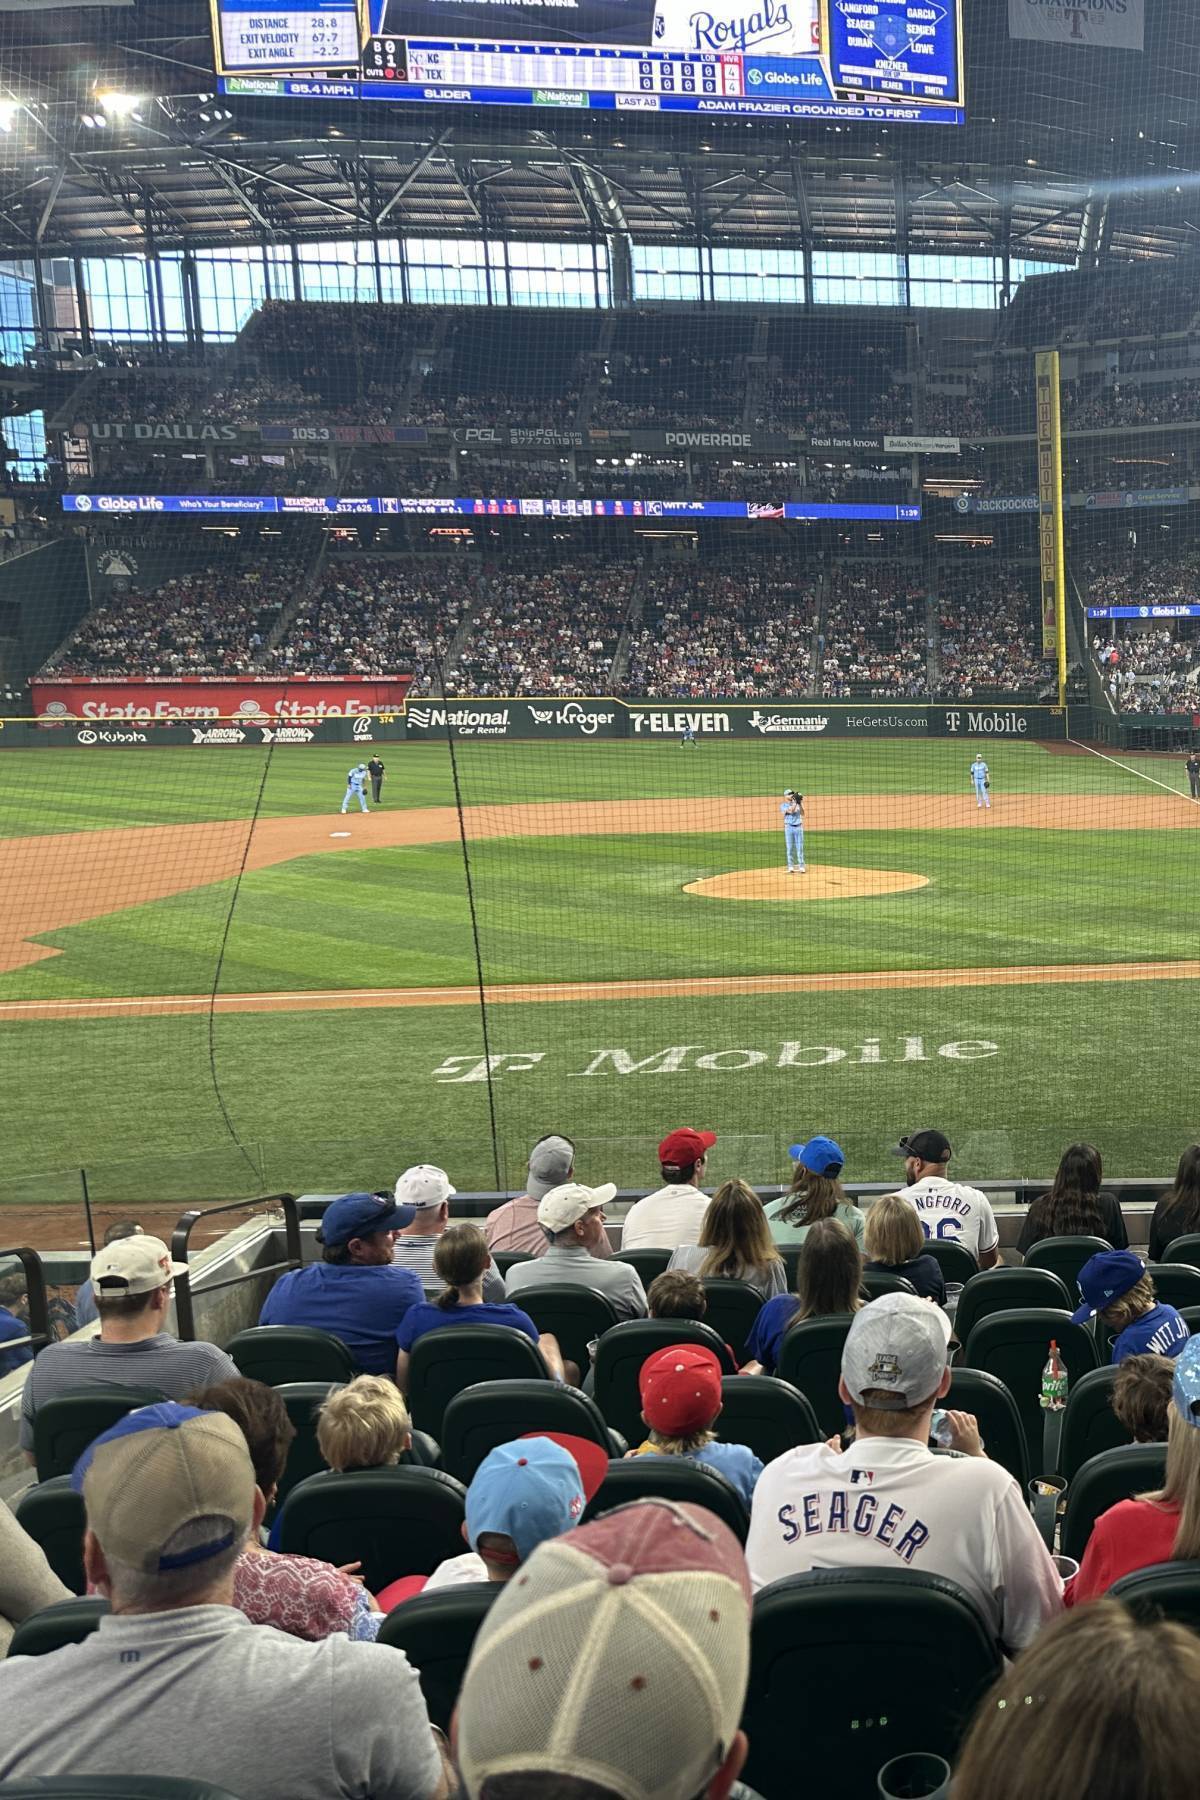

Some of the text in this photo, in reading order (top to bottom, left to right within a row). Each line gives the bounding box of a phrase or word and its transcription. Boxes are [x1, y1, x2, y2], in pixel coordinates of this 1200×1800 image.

[840, 3, 878, 15] LANGFORD
[907, 8, 936, 20] GARCIA
[250, 18, 337, 28] DISTANCE 28.8
[689, 0, 792, 51] Royals
[240, 32, 338, 44] EXIT VELOCITY 67.7
[249, 48, 267, 58] EXIT
[269, 47, 294, 58] ANGLE
[374, 40, 395, 53] B 0
[911, 44, 934, 55] LOWE
[374, 54, 396, 67] S 1
[427, 53, 439, 64] KC
[701, 54, 715, 62] LOB
[425, 69, 442, 80] TEX
[765, 72, 822, 86] Globe Life
[241, 78, 279, 90] National
[290, 84, 354, 95] 85.4 MPH
[424, 89, 471, 100] SLIDER
[546, 91, 583, 102] National
[618, 98, 657, 107] LAST AB
[698, 100, 921, 119] ADAM FRAZIER GROUNDED TO FIRST
[1040, 388, 1049, 438] THE
[92, 423, 237, 440] UT DALLAS
[291, 428, 329, 440] 105.3
[465, 429, 502, 441] PGL
[665, 432, 752, 447] POWERADE
[811, 438, 831, 447] Real
[833, 438, 851, 447] fans
[853, 438, 880, 448] know.
[1042, 453, 1051, 500] HOT
[98, 497, 137, 510] Globe
[139, 497, 163, 510] Life
[203, 501, 219, 509] Your
[977, 498, 1038, 511] Jackpocket
[1043, 516, 1053, 580] ZONE
[1176, 607, 1190, 615] Life
[379, 716, 394, 724] 374
[556, 703, 614, 734] Kroger
[771, 715, 828, 725] Germania
[847, 716, 928, 728] HeGetsUs.com
[946, 712, 1027, 732] T Mobile
[206, 728, 238, 738] ARROW
[275, 728, 305, 738] ARROW
[477, 726, 506, 734] Rental
[100, 731, 147, 742] Kubota
[566, 1036, 999, 1077] Mobile
[916, 1196, 971, 1217] NGFORD
[1146, 1322, 1175, 1355] WITT
[777, 1490, 930, 1564] SEAGER
